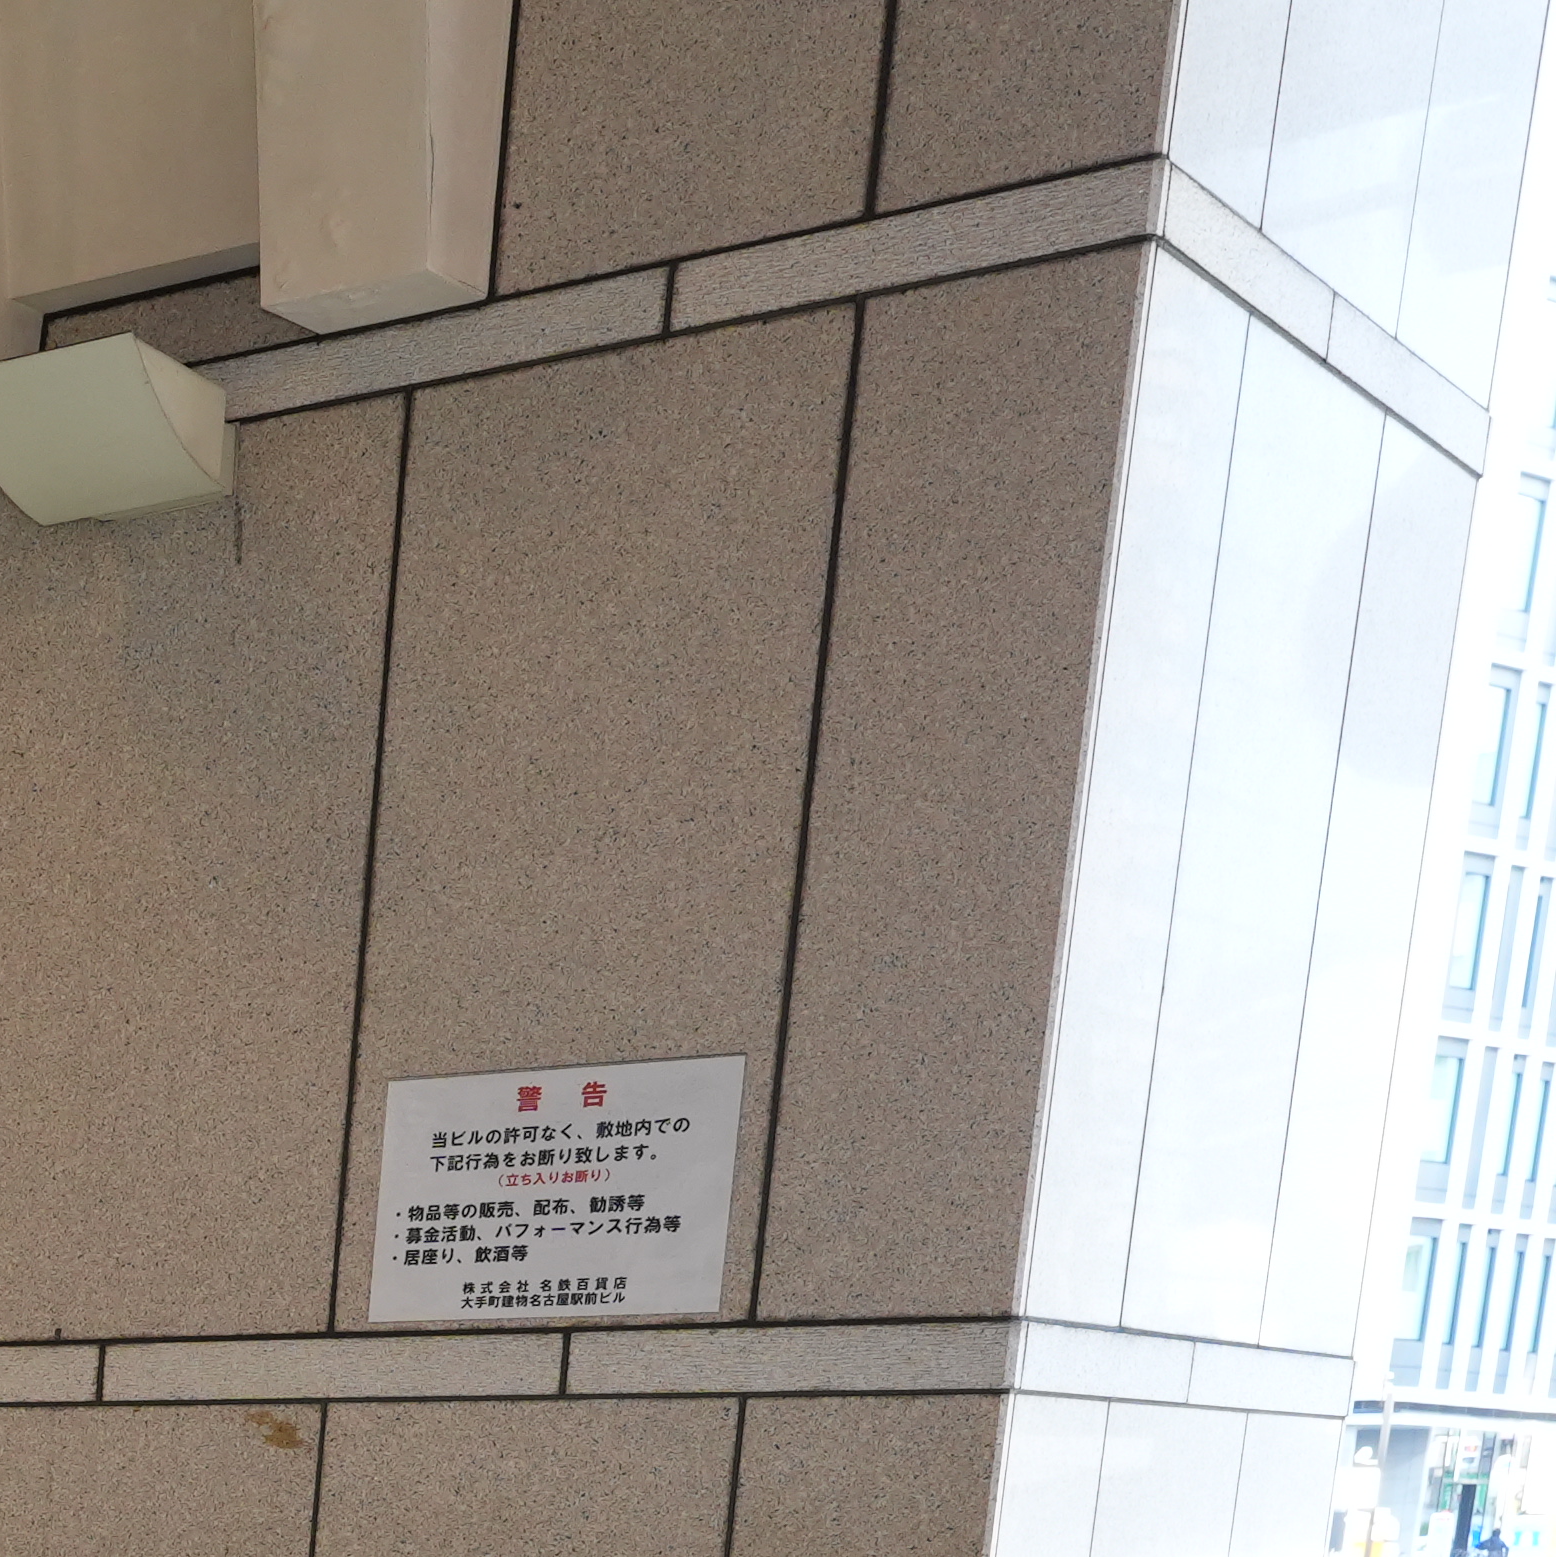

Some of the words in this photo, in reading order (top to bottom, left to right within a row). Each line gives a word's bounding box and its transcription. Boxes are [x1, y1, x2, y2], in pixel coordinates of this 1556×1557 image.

[431, 1117, 691, 1148] 当ビルの許可なく、敷地内での
[430, 1145, 658, 1173] 下記行為をお断り致します。
[462, 1281, 530, 1295] 株式会社
[461, 1292, 626, 1309] 大手町建物名古屋駅前ビル
